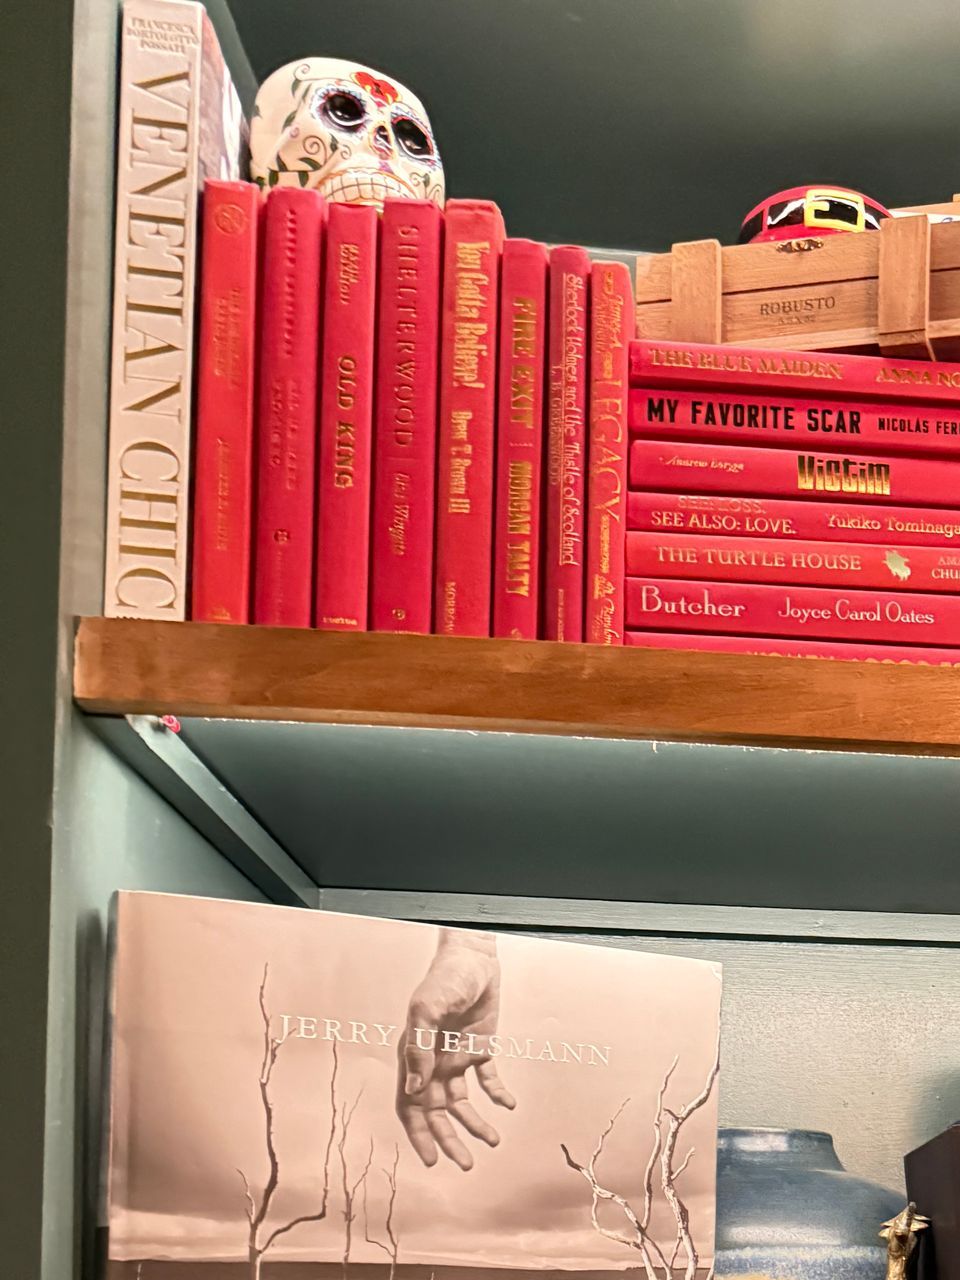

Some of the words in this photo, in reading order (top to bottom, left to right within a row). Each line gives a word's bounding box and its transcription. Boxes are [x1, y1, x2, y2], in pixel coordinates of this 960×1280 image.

[122, 62, 191, 421] VENETIAN
[454, 241, 489, 269] You
[760, 297, 837, 316] ROBUSTO
[450, 321, 484, 388] Believe!
[647, 398, 677, 423] MY
[691, 400, 796, 431] FAVORITE
[807, 409, 862, 434] SCAR
[878, 417, 930, 433] NICOLÁS
[798, 454, 891, 496] Victim
[114, 440, 183, 613] CHIC
[651, 511, 684, 527] SEE
[688, 514, 741, 530] ALSO:
[746, 517, 797, 534] LOVE.
[826, 513, 880, 532] Yukiko
[655, 546, 698, 564] THE
[706, 549, 793, 568] TURTLE
[797, 552, 862, 571] HOUSE
[641, 585, 746, 618] Butcher
[778, 596, 831, 621] Joyce
[835, 599, 881, 623] Carol
[885, 601, 934, 626] Oates
[276, 1014, 397, 1047] JERRY
[413, 1027, 612, 1066] UELSMANN
